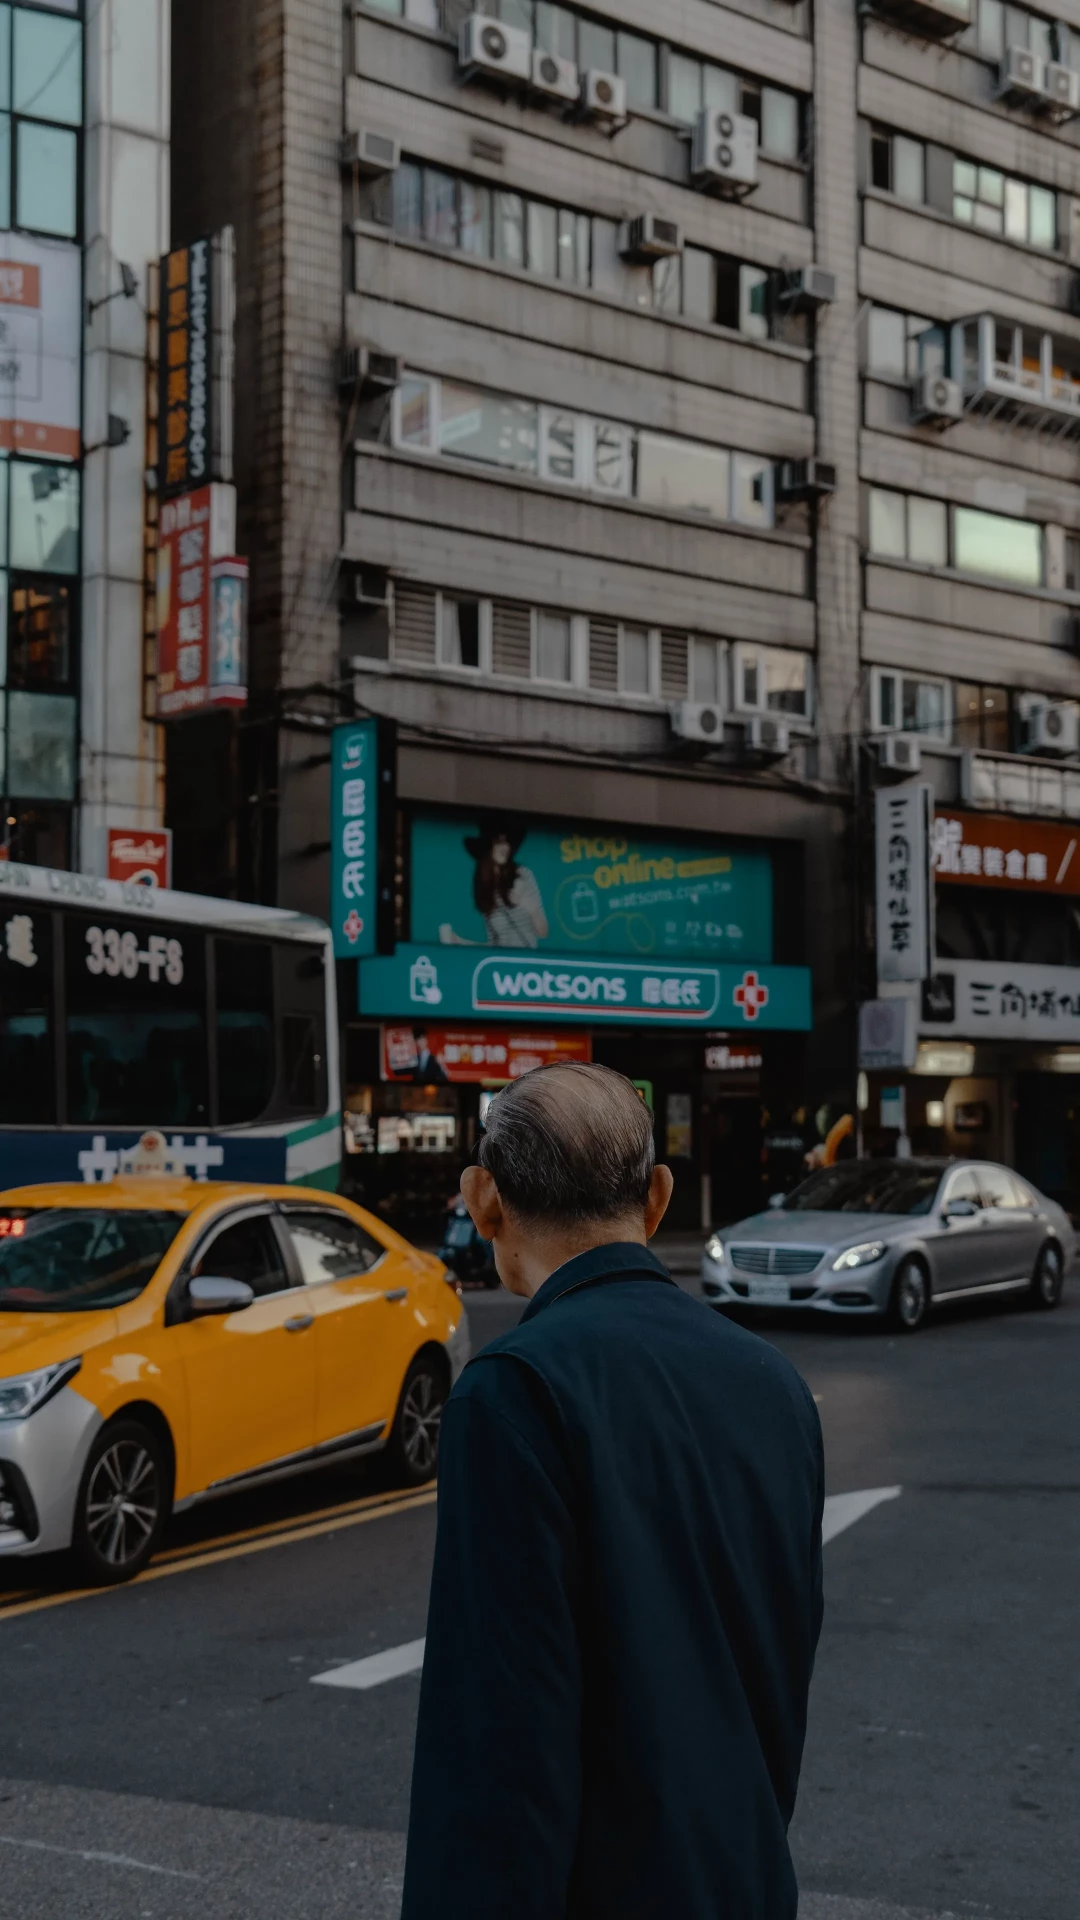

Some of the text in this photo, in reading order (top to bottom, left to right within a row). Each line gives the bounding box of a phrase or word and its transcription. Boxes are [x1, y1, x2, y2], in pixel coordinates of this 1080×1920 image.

[560, 834, 629, 864] shop
[593, 853, 675, 889] online
[85, 926, 184, 985] 336-FS
[493, 970, 701, 1006] watsons 屈臣氏
